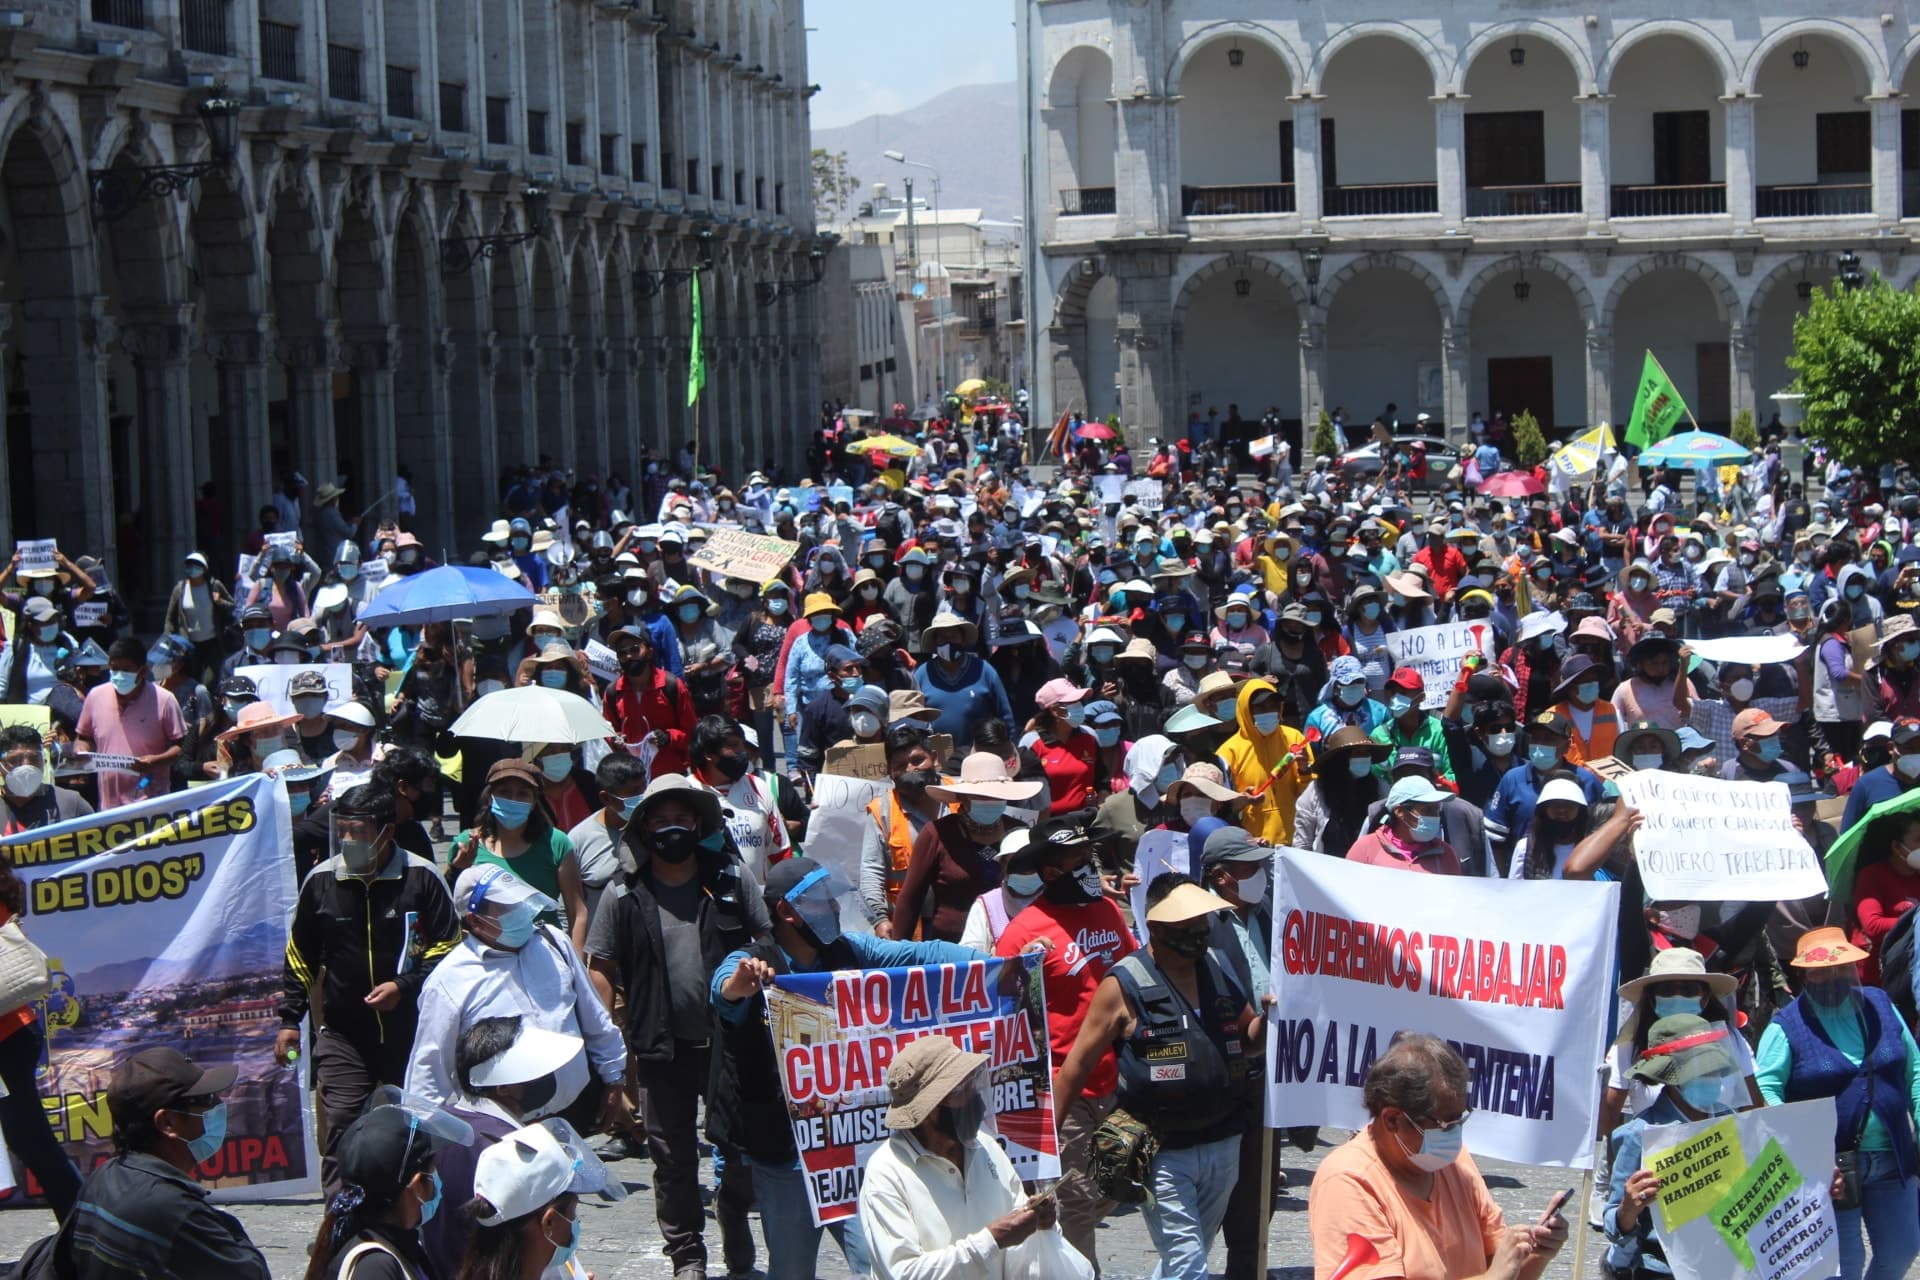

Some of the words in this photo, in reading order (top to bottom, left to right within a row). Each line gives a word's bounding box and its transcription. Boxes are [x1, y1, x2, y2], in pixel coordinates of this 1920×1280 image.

[1402, 634, 1425, 659] NO
[1437, 632, 1445, 650] A
[1453, 629, 1472, 648] LA
[733, 824, 752, 835] NTO
[736, 836, 763, 848] MINGO
[36, 877, 86, 911] DE
[1283, 908, 1423, 992] QUEREMOS
[1428, 934, 1567, 1010] TRABAJAR
[834, 973, 891, 1030] NO
[903, 968, 930, 1023] A
[940, 961, 991, 1016] LA
[1275, 1018, 1315, 1083] NO
[1317, 1020, 1339, 1083] A
[1345, 1023, 1377, 1087] LA
[1155, 1067, 1181, 1079] SKIL
[797, 1118, 826, 1151] DE
[1656, 1131, 1723, 1172] AREQUIPA
[1659, 1172, 1679, 1189] NO
[1682, 1146, 1730, 1178] QUIERE
[1663, 1169, 1722, 1205] HAMBRE
[1721, 1154, 1784, 1229] QUEREMOS
[1731, 1171, 1791, 1240] TRABAJAR
[1765, 1209, 1783, 1228] NO
[1783, 1195, 1801, 1214] AL
[1802, 1198, 1822, 1218] DE
[1768, 1217, 1824, 1266] CENTROS
